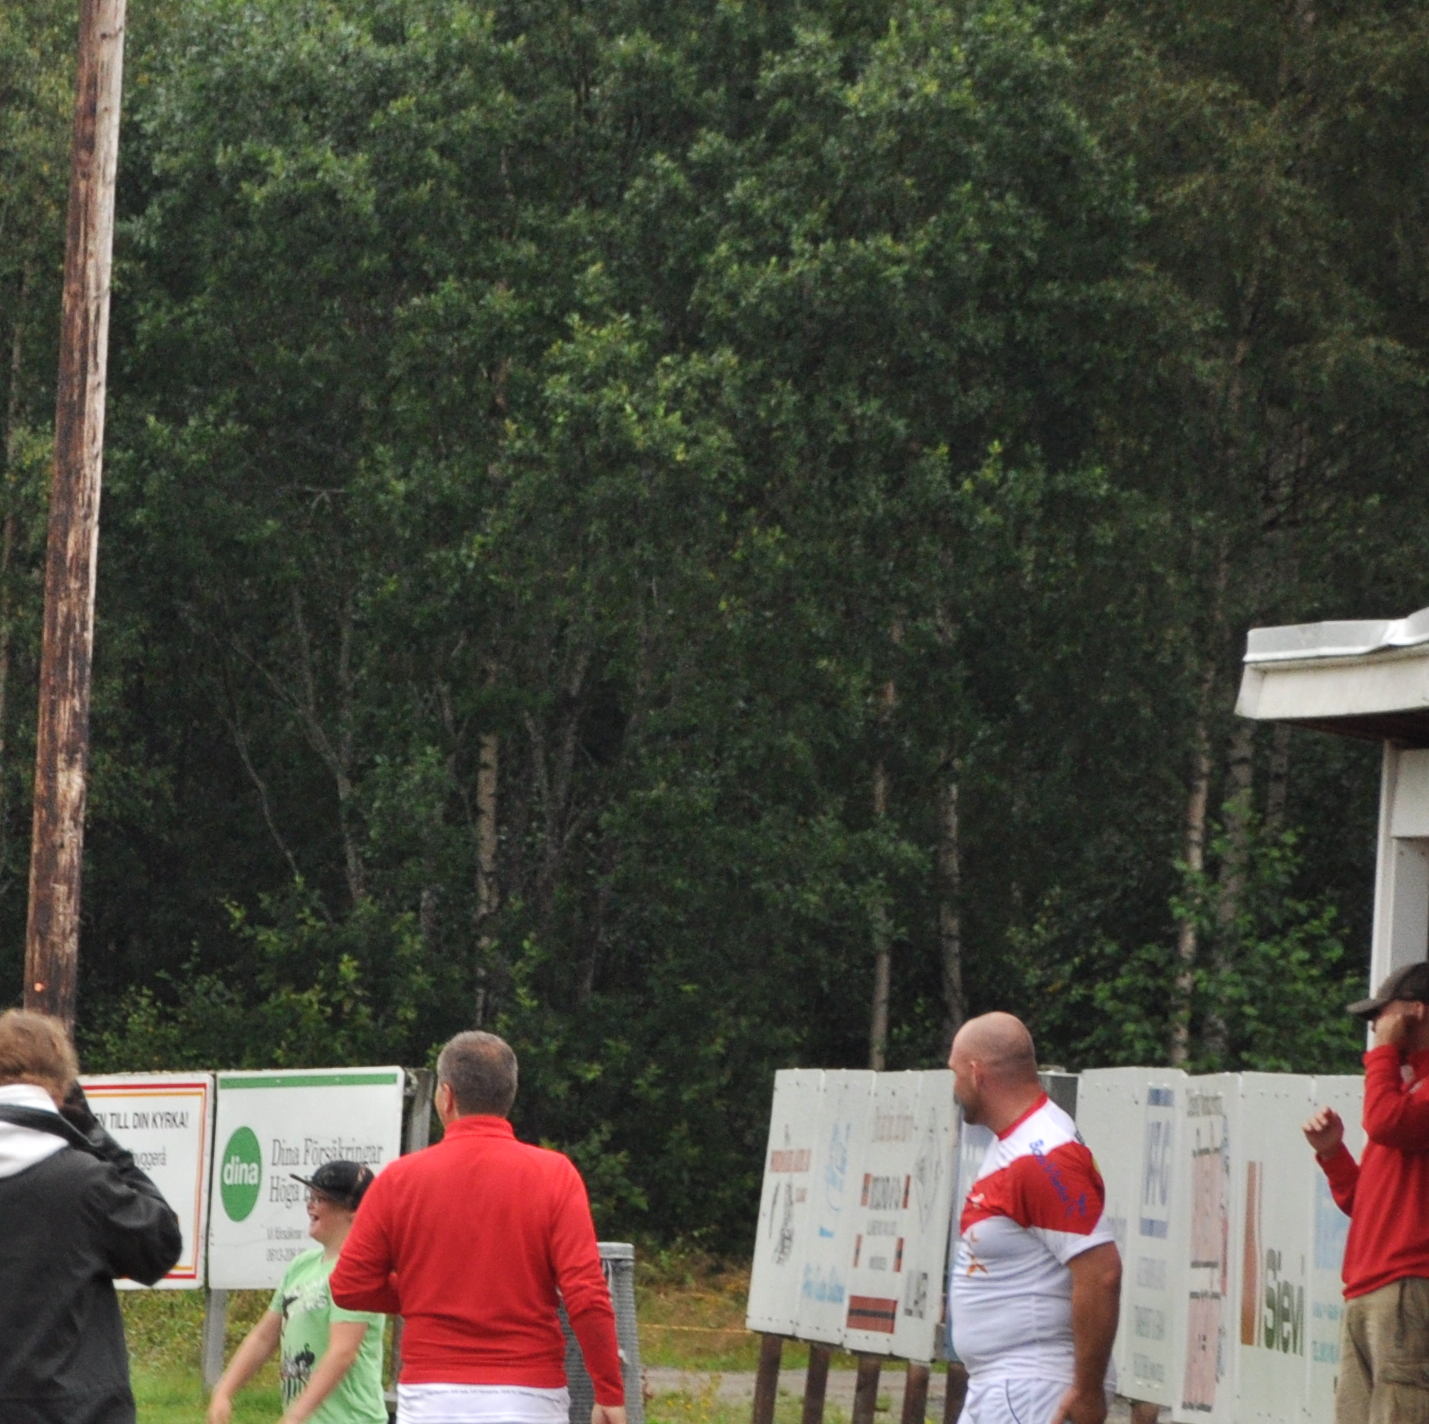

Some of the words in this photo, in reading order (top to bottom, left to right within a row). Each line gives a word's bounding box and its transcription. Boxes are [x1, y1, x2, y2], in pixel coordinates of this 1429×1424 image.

[109, 1112, 129, 1129] TILL
[132, 1112, 149, 1129] DIN
[151, 1111, 189, 1129] KYRKA!
[272, 1138, 300, 1166] Dina
[303, 1137, 384, 1166] Försäkringar
[223, 1155, 259, 1186] dina
[1264, 1248, 1304, 1356] Sievi
